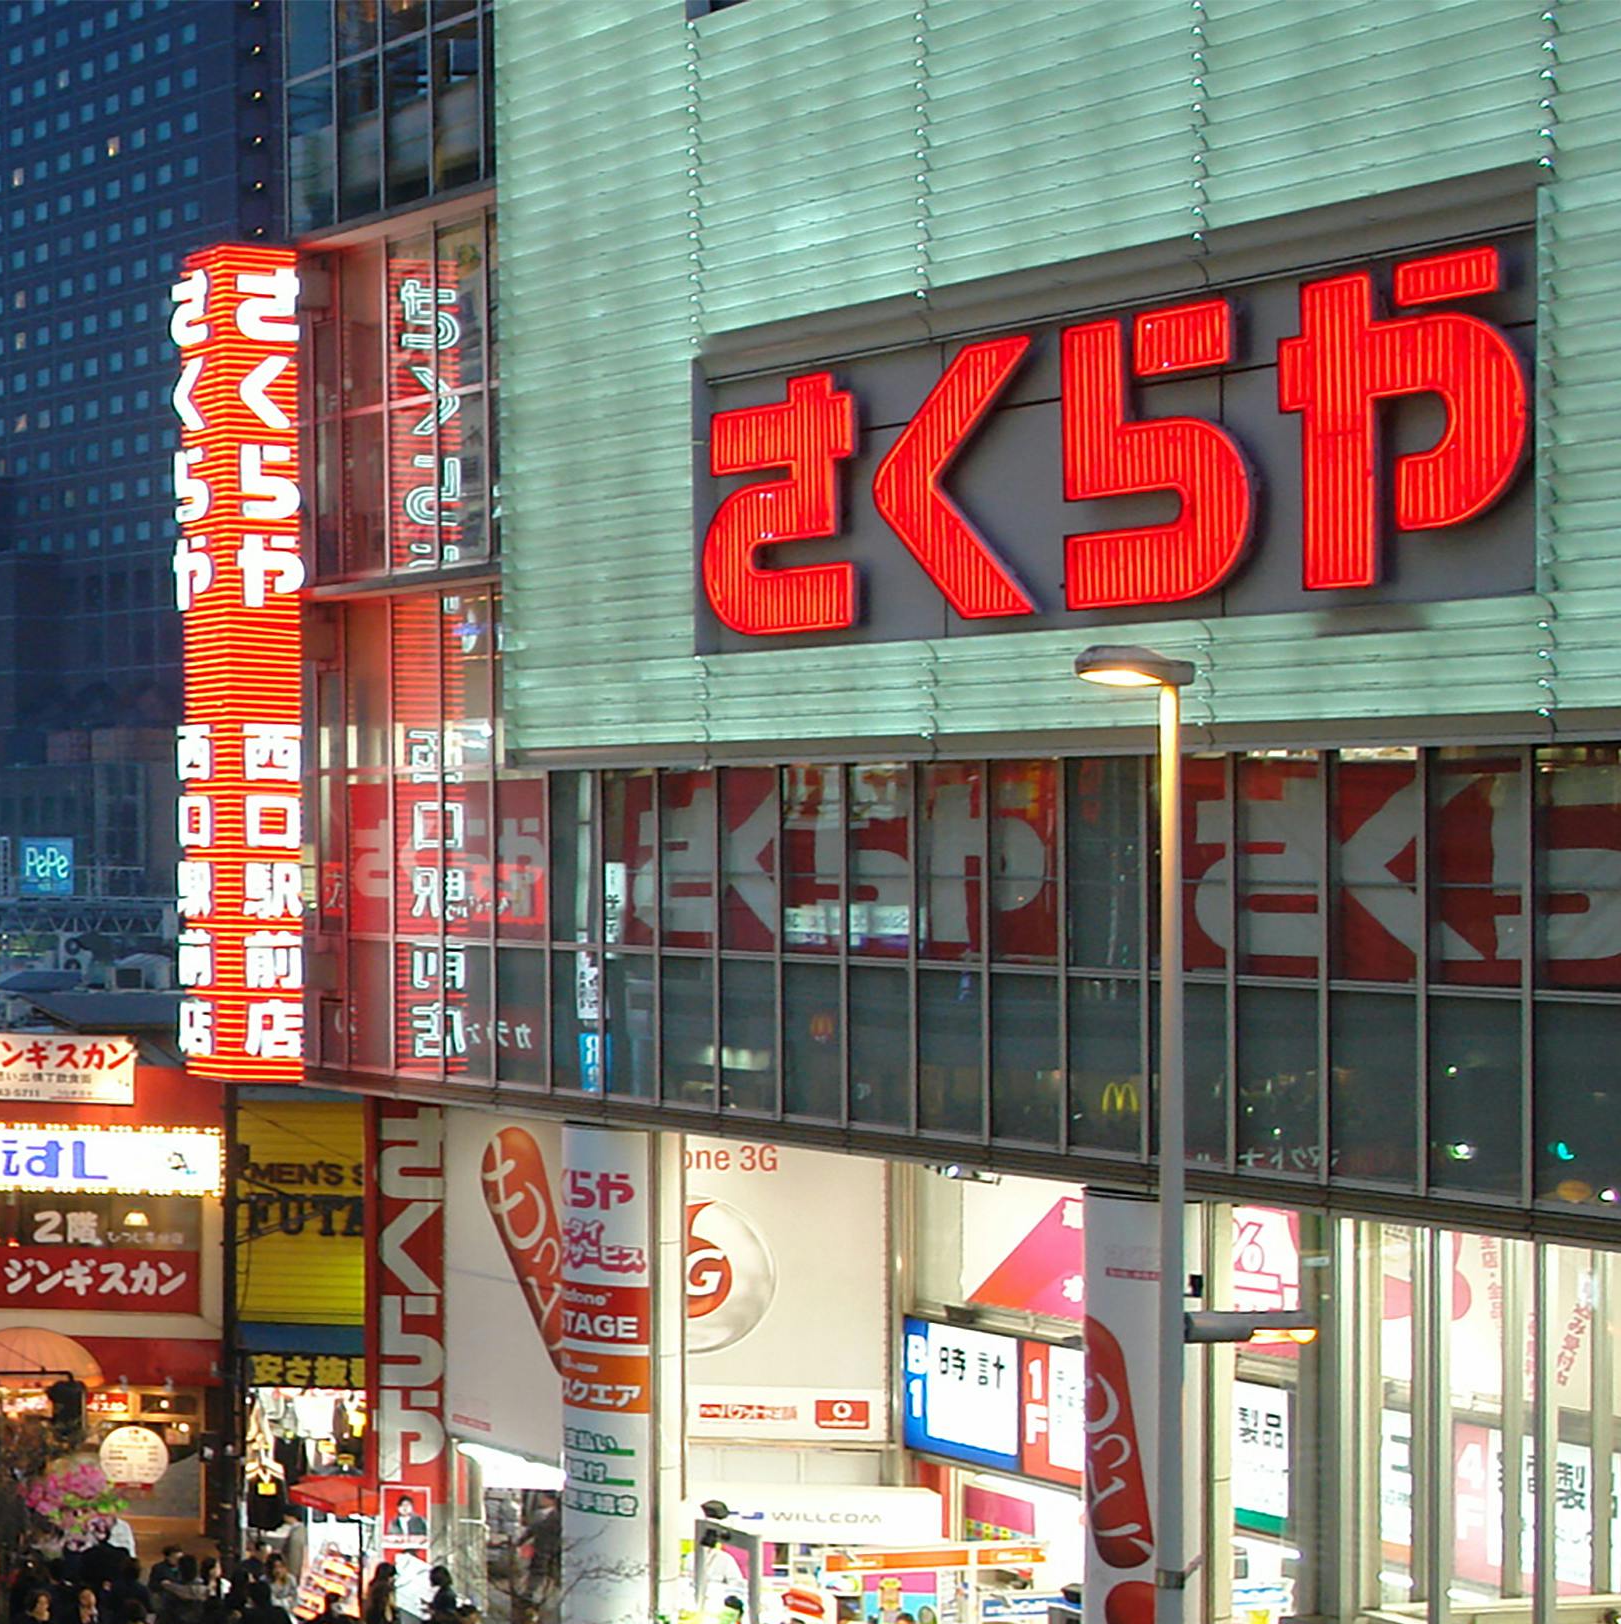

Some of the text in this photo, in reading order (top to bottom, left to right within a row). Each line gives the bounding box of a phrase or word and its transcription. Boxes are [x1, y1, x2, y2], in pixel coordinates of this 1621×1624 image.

[171, 268, 214, 612] さくらや
[236, 267, 306, 608] さくらや
[701, 246, 1529, 638] さくらや
[25, 846, 70, 879] PePe
[242, 722, 303, 1059] 西口駅前店
[739, 1143, 778, 1172] 3G
[33, 1210, 105, 1247] 2階
[3, 1257, 187, 1297] ジンギスカン
[375, 1106, 445, 1482] さくらや
[906, 1333, 929, 1419] B1
[939, 1347, 1006, 1389] 時計
[1024, 1358, 1049, 1445] 1F
[771, 1511, 882, 1524] WILLCOM
